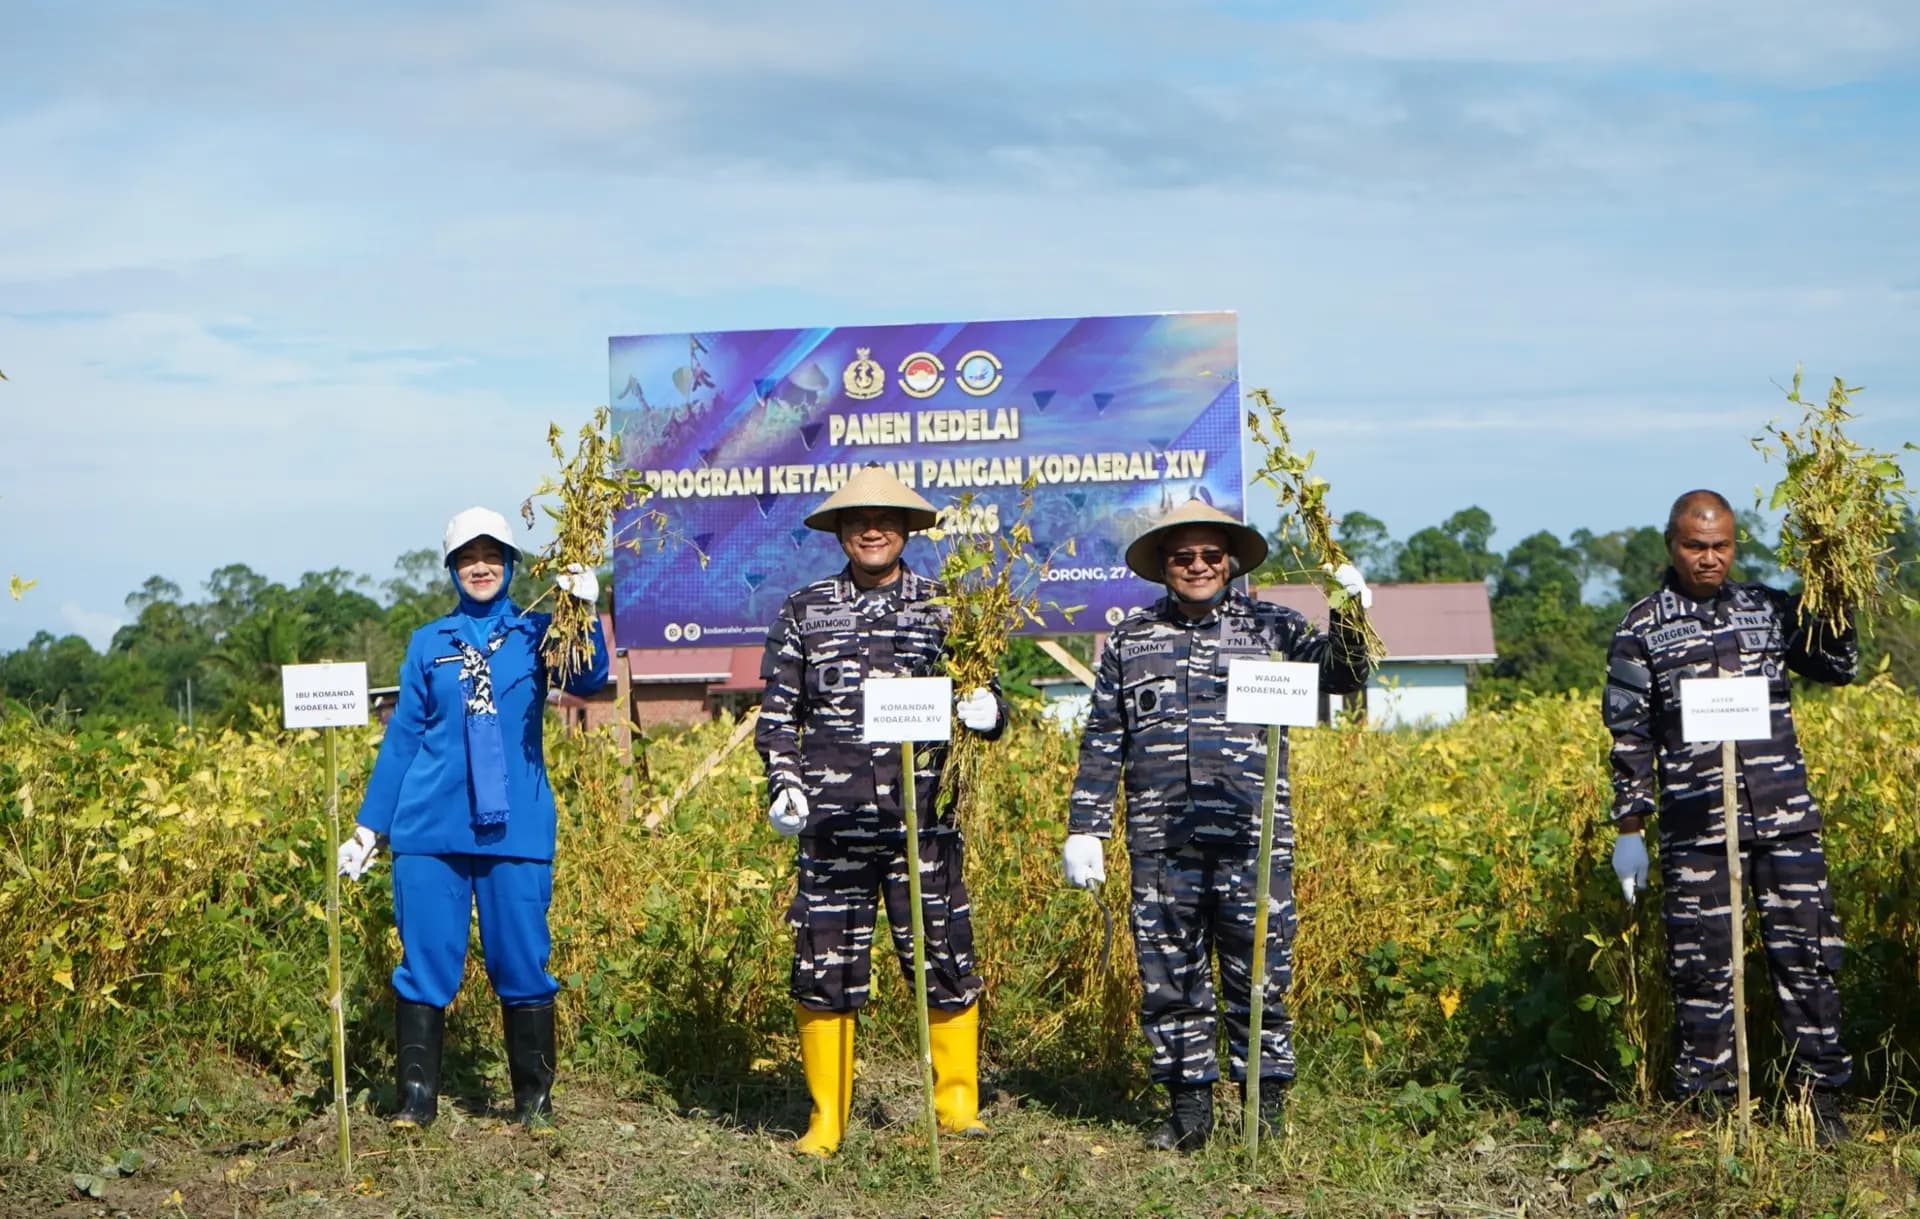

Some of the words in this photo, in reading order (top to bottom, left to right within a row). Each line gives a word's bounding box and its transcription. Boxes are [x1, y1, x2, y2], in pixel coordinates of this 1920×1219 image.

[829, 412, 911, 446] PANEN
[917, 408, 1019, 443] KEDELAI
[646, 466, 763, 498] PROGRAM
[922, 456, 1021, 488] PANGAN
[1028, 452, 1159, 484] KODAERAL
[1163, 449, 1206, 479] XIV
[1110, 566, 1127, 579] 27
[805, 618, 850, 631] DJATMOKO
[1735, 616, 1758, 625] TNI
[1651, 624, 1697, 646] SOEGENG
[1225, 637, 1246, 646] TNI
[1127, 643, 1167, 657] TOMMY
[1255, 674, 1290, 683] WADAN
[295, 691, 310, 699] IBU
[312, 690, 355, 698] KOMANDA
[1236, 685, 1288, 695] KODAERAL
[1292, 688, 1308, 696] XIV
[294, 703, 339, 711] KODAERAL
[342, 702, 357, 710] XIV
[880, 703, 935, 711] KOMANDAN
[873, 715, 922, 723] KODAERAL
